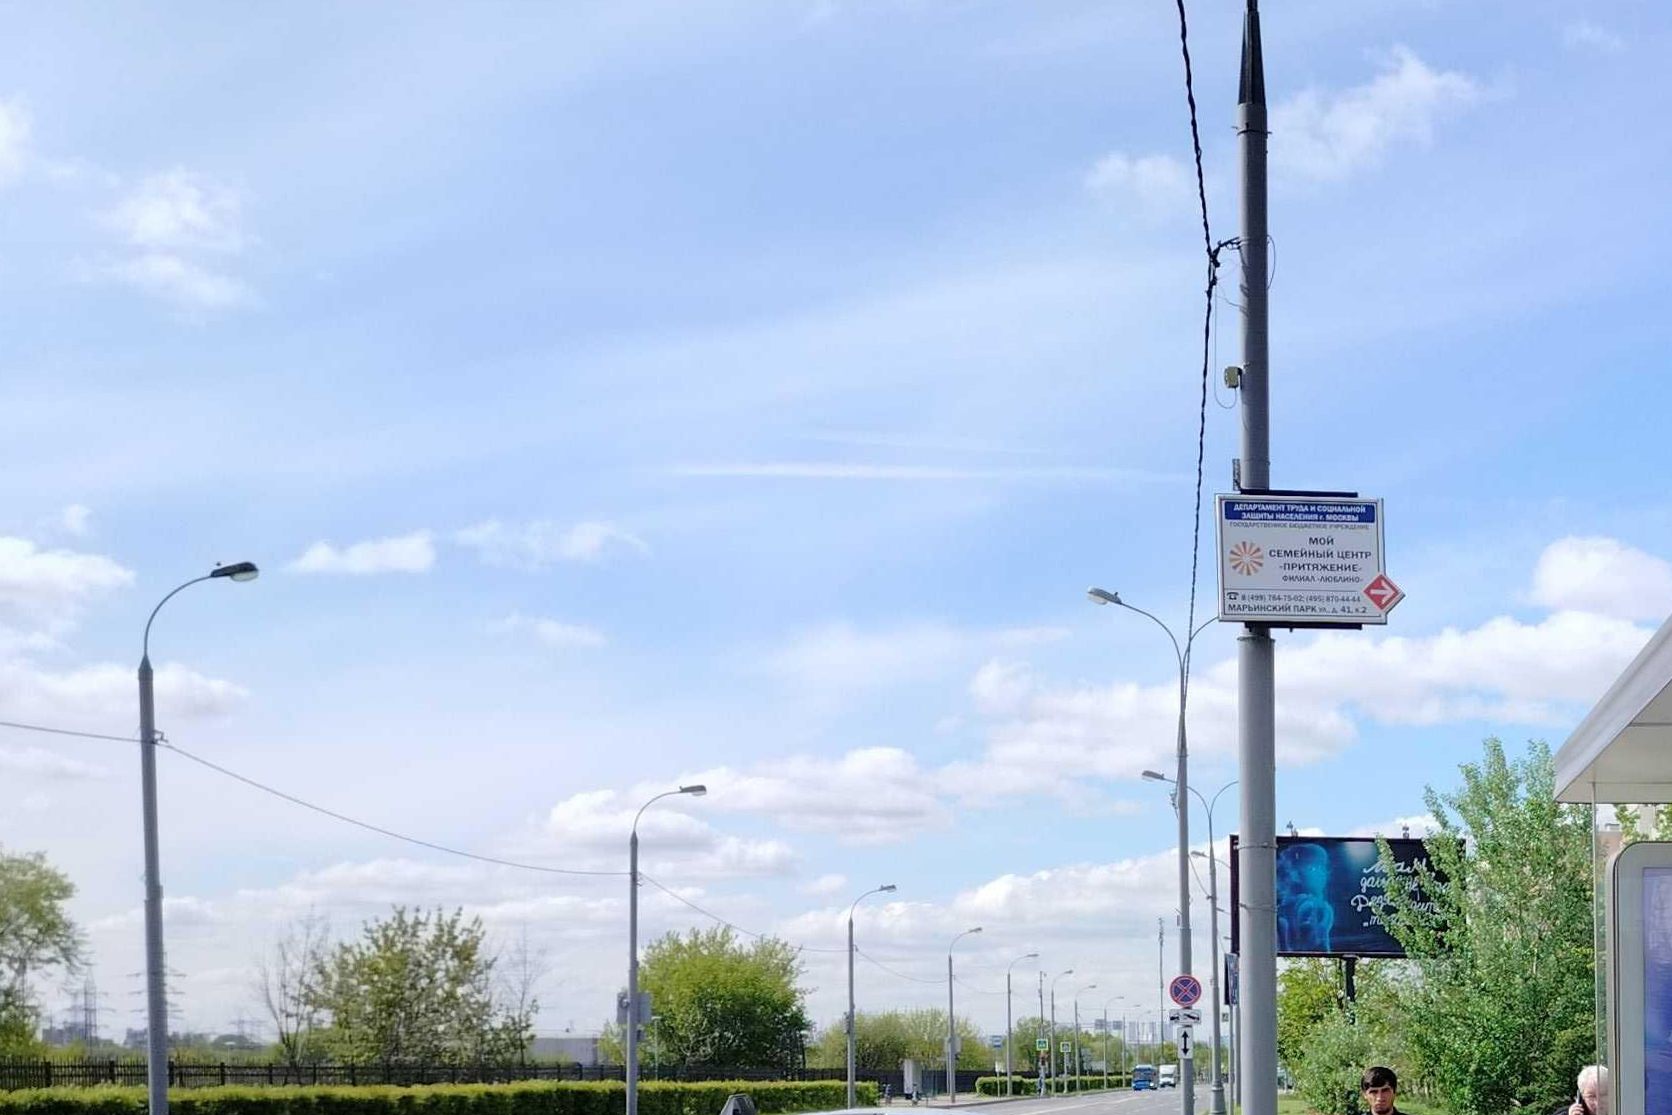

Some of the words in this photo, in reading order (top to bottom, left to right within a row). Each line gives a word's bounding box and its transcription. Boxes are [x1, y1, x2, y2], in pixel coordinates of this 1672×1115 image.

[1308, 535, 1334, 545] МОЙ
[1269, 547, 1334, 559] СЕМЕЙНЫЙ
[1337, 550, 1372, 560] ЦЕНТР
[1228, 602, 1291, 612] МАРЬИНСКИЙ
[1293, 605, 1317, 613] ПАРК
